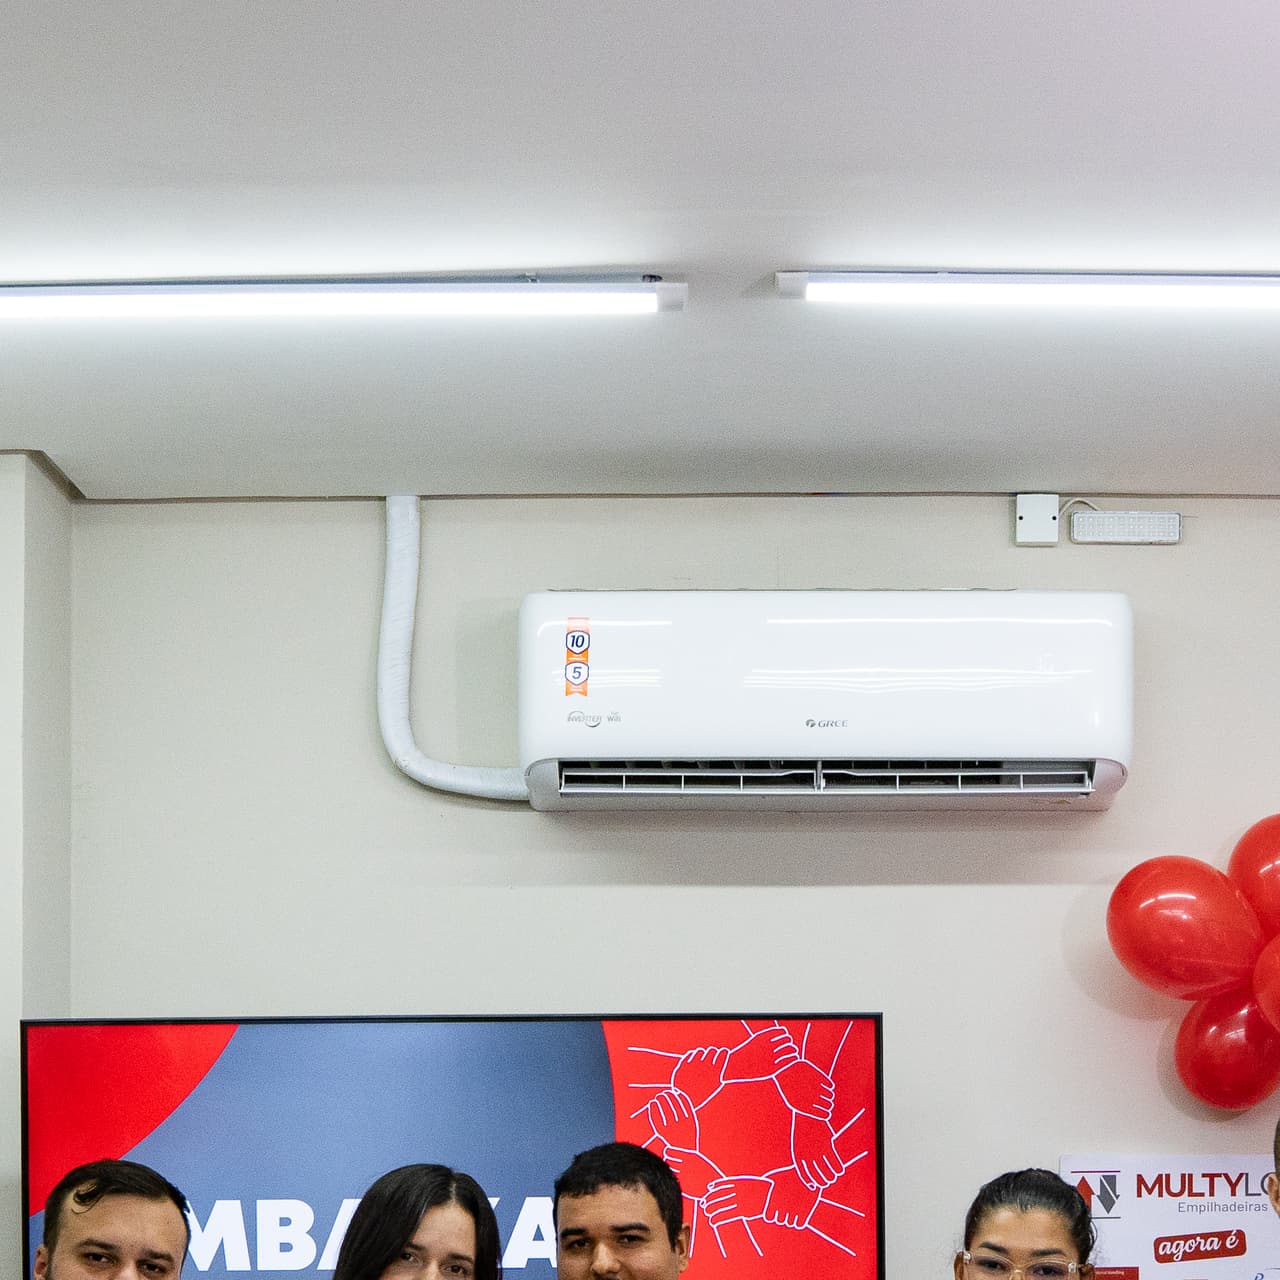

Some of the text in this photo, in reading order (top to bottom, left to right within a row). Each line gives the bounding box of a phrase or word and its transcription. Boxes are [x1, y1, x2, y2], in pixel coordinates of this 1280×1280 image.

[570, 634, 585, 648] 10
[572, 666, 583, 680] 5
[1178, 1201, 1268, 1216] Empilhadeiras
[1158, 1231, 1239, 1261] agora é
